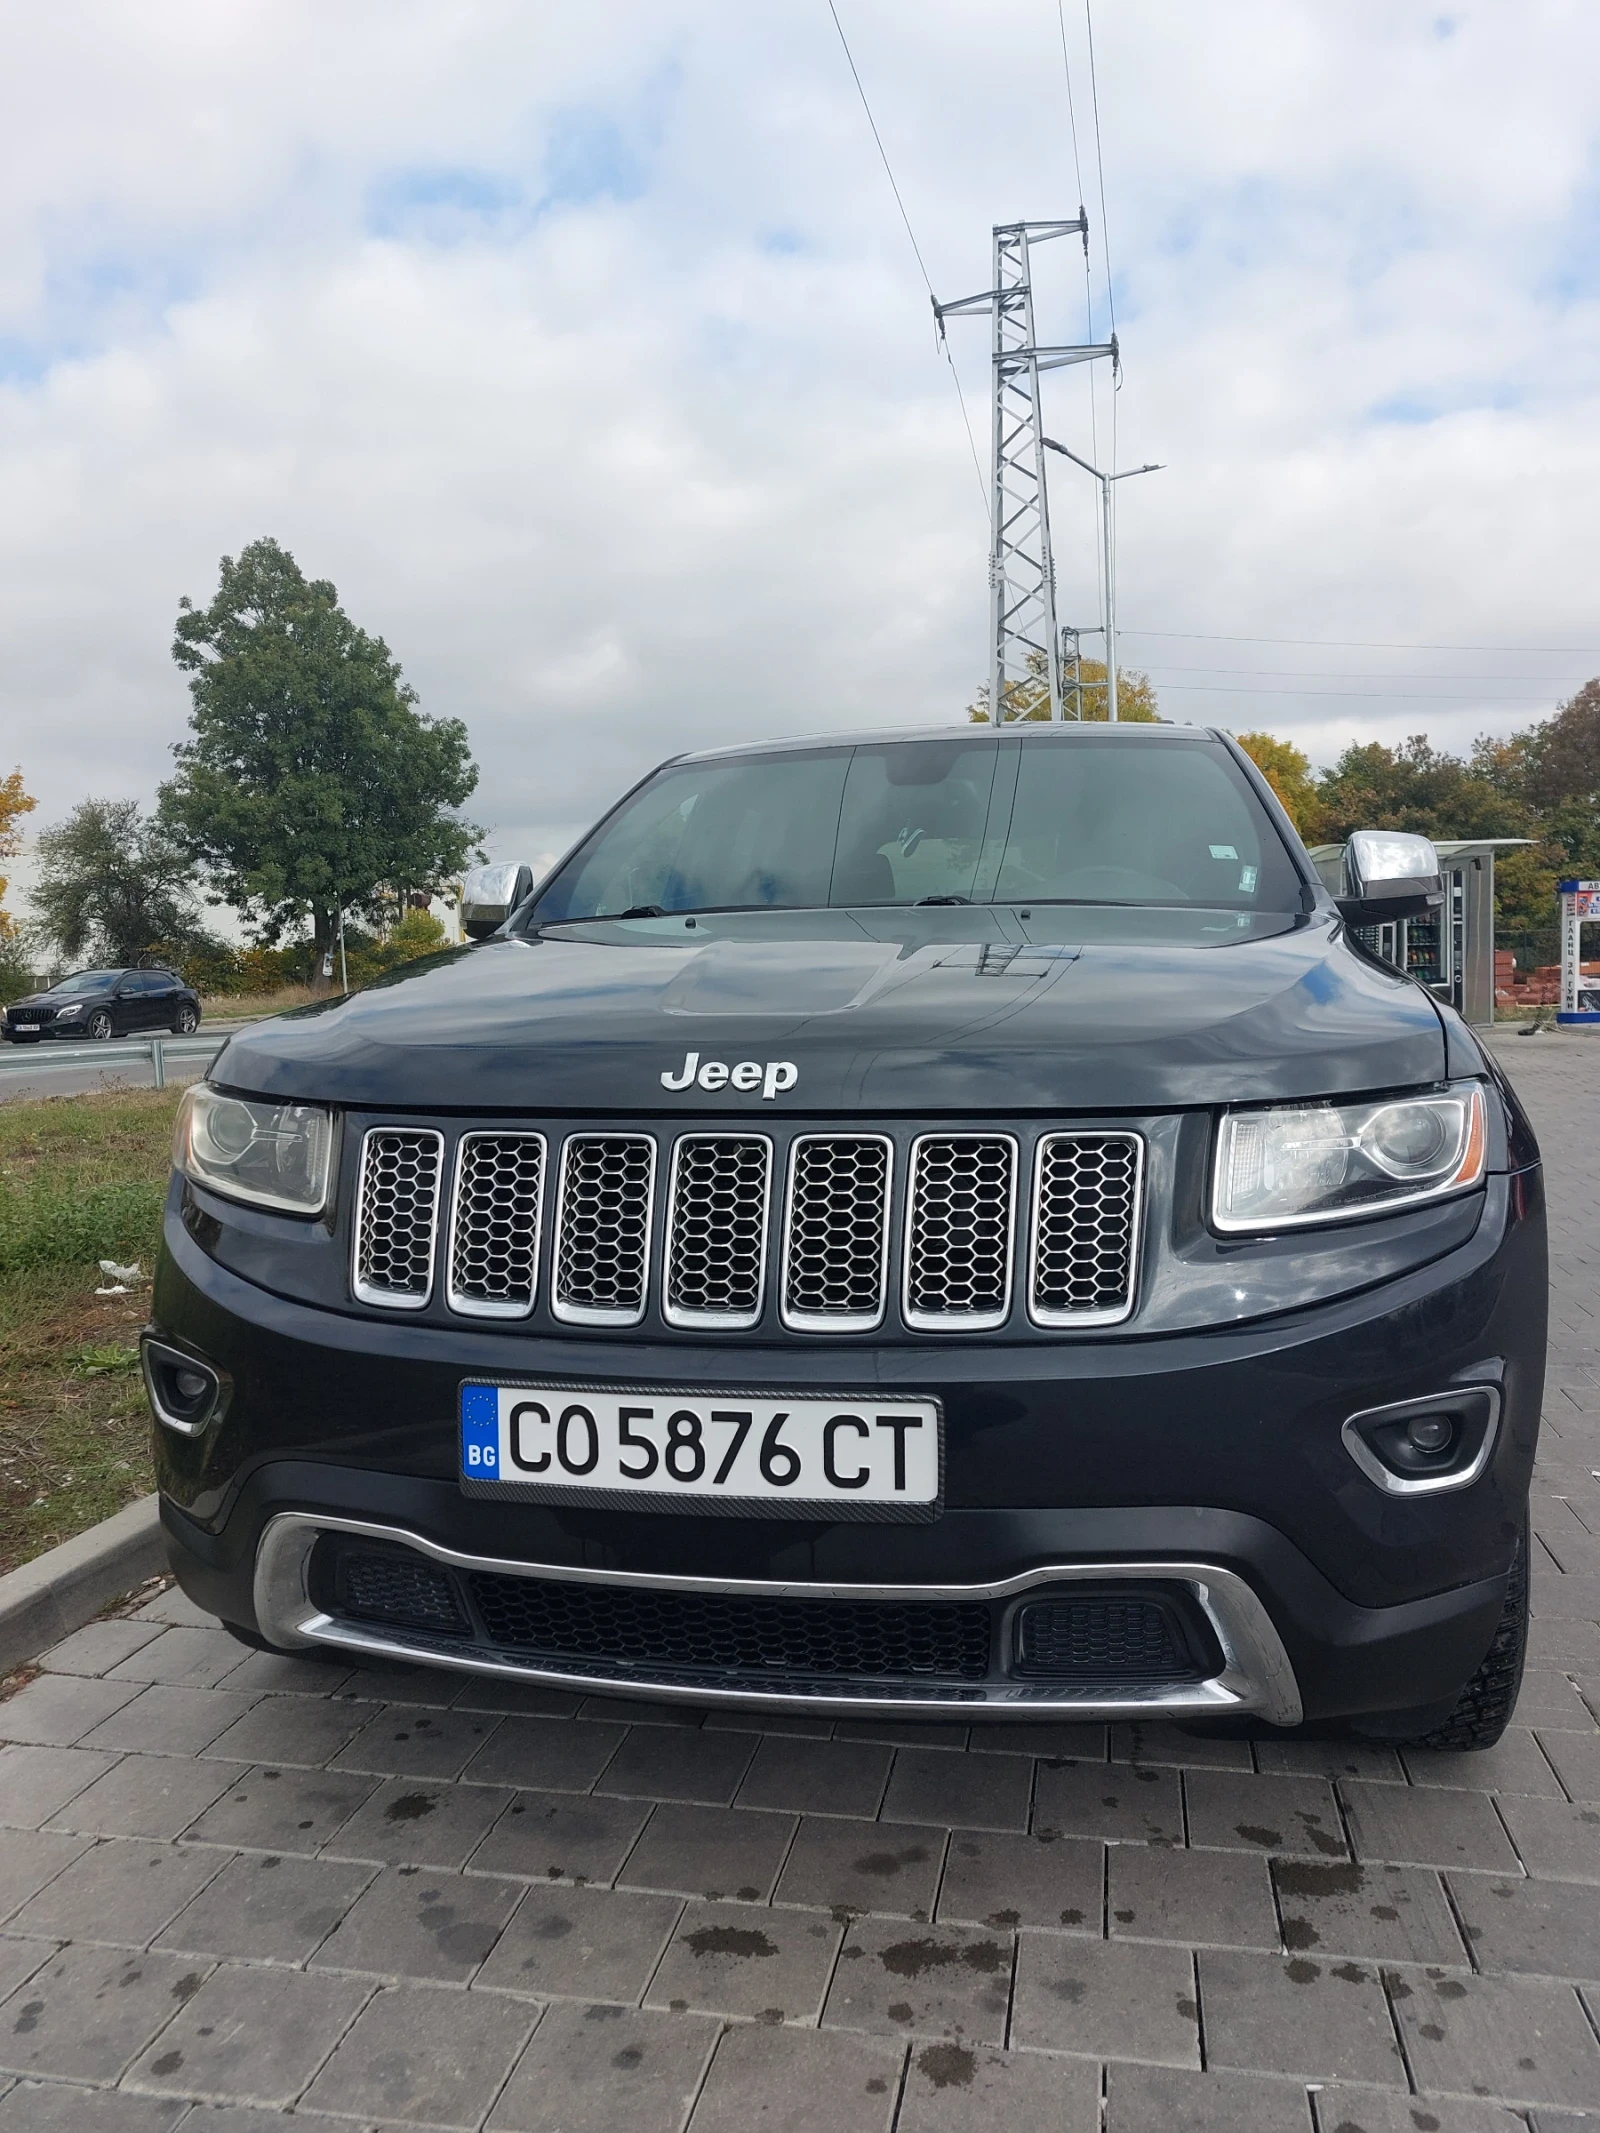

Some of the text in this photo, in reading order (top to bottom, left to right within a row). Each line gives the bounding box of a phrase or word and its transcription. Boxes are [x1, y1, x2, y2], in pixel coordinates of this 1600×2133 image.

[1588, 882, 1600, 890] АВ
[660, 1052, 798, 1101] Jeep
[468, 1444, 496, 1467] BG
[618, 1406, 801, 1487] 5876
[823, 1414, 923, 1491] CT
